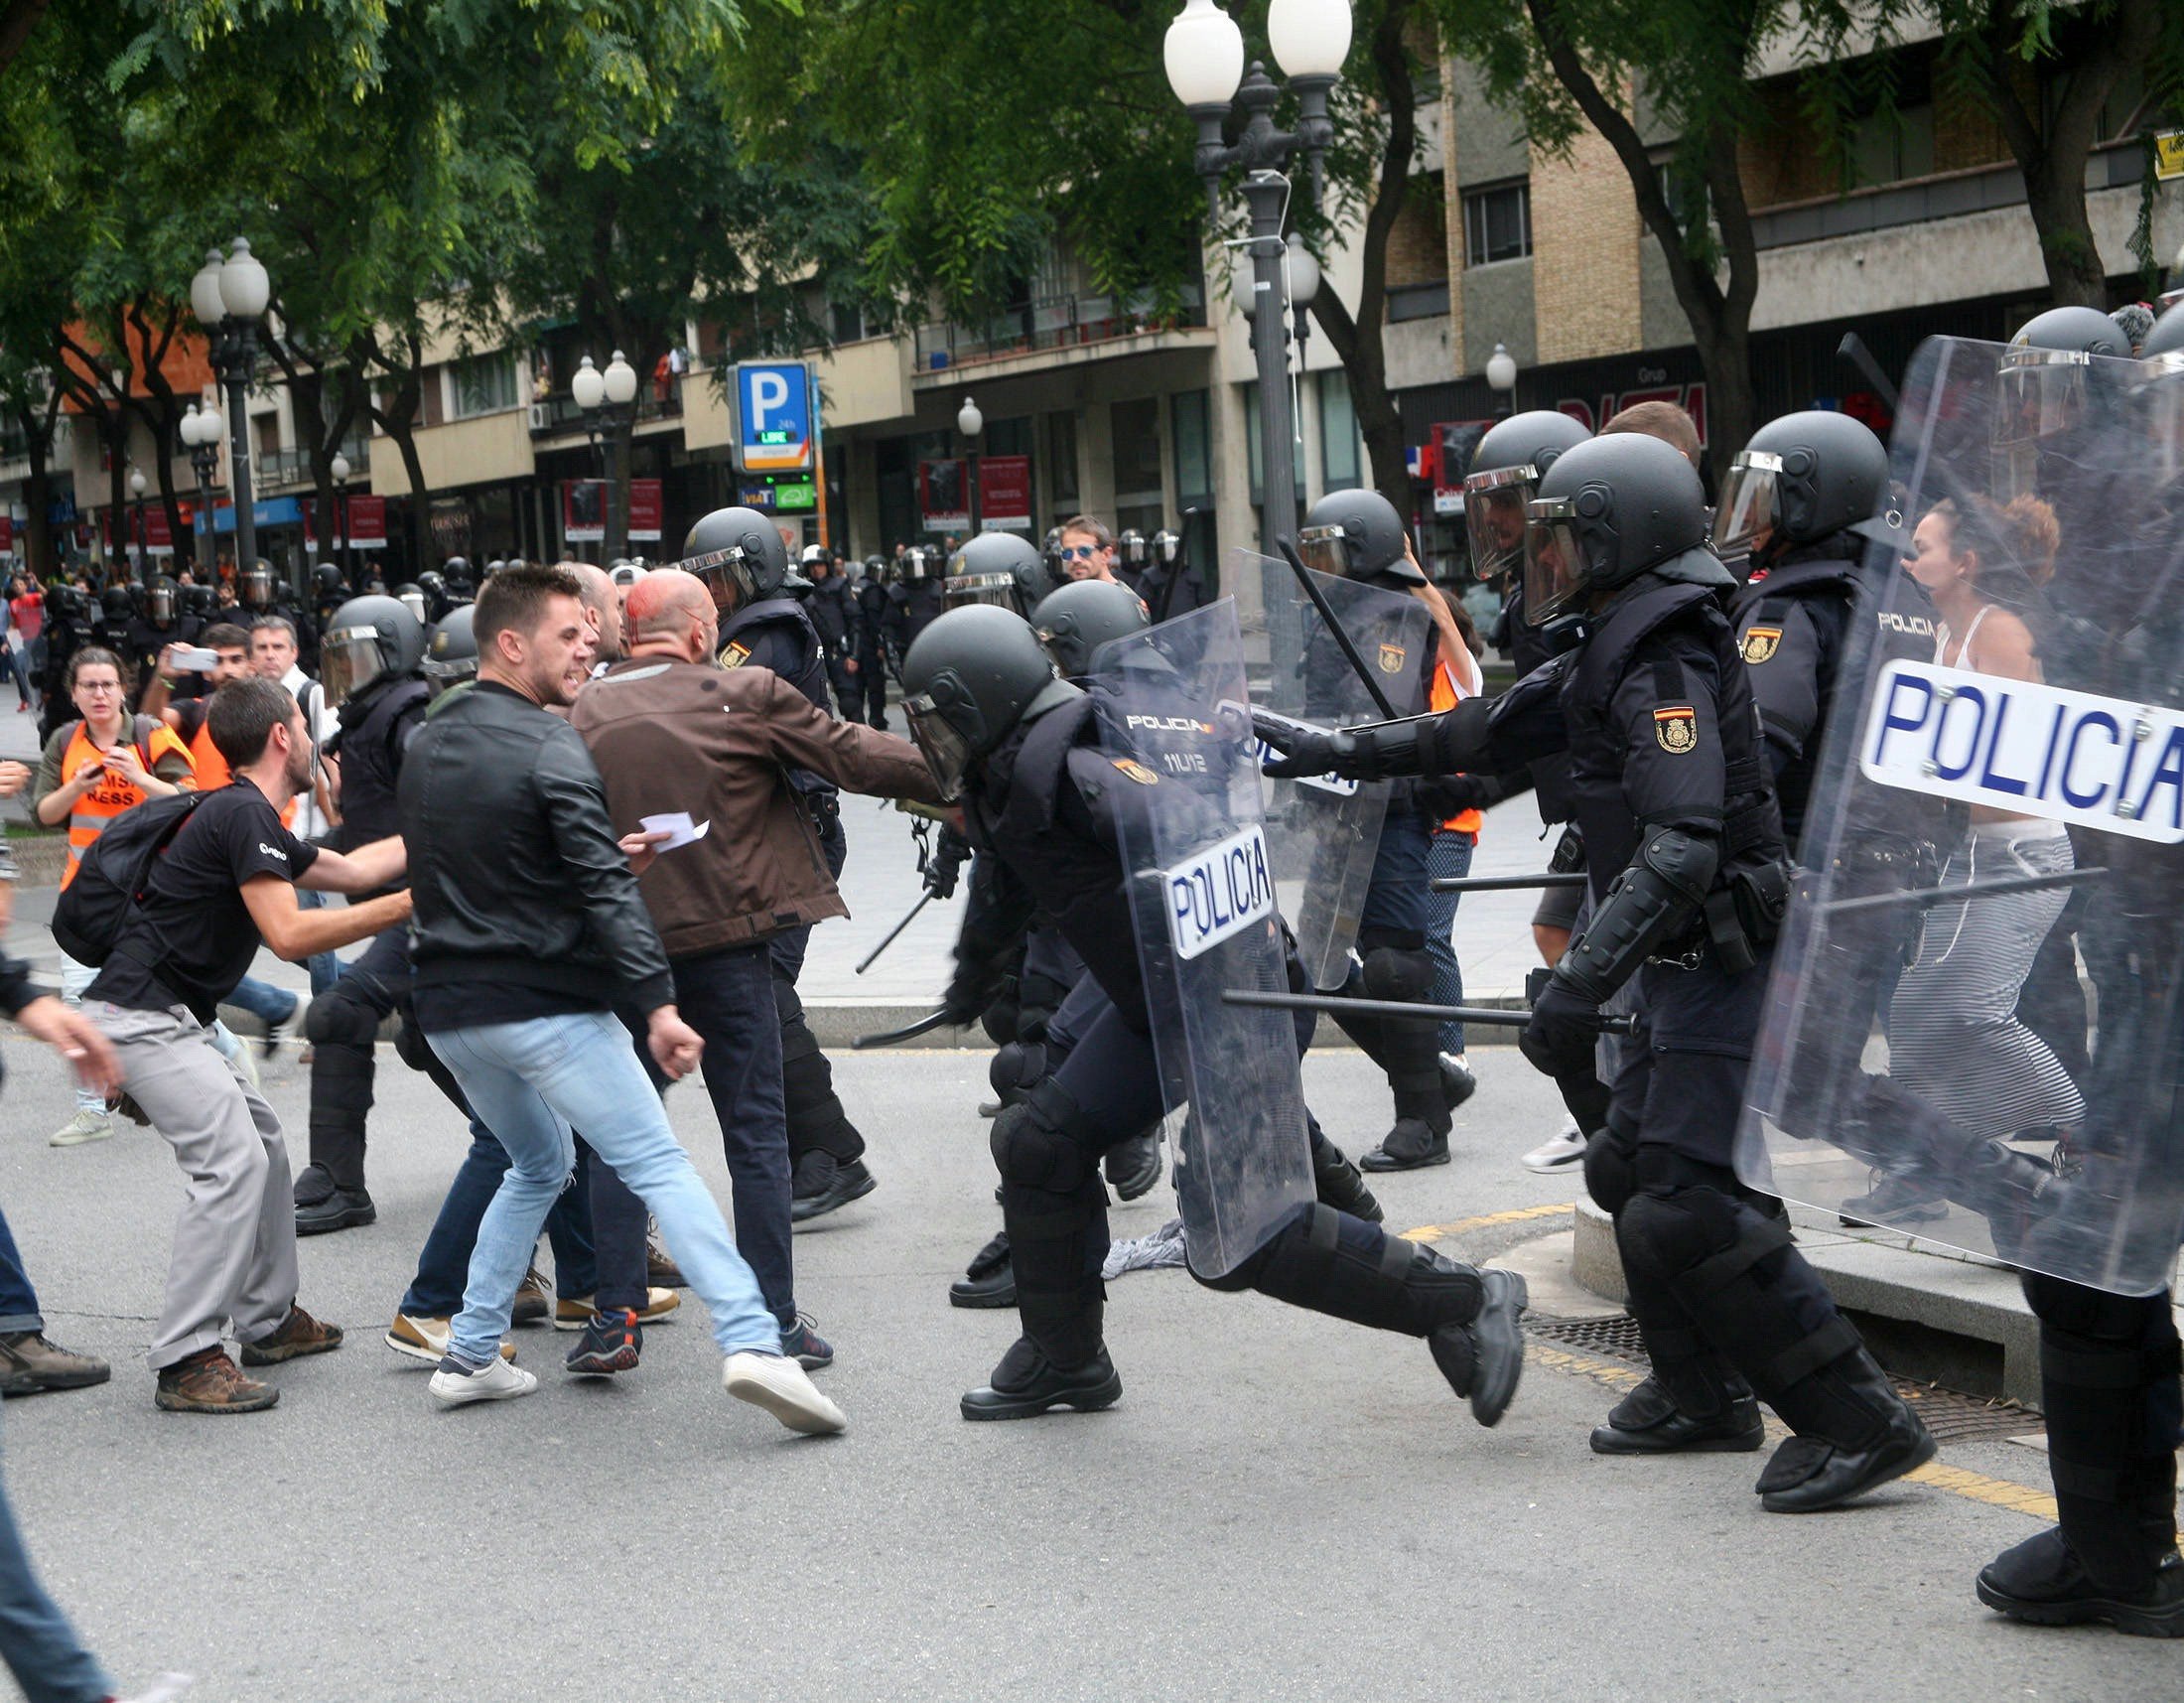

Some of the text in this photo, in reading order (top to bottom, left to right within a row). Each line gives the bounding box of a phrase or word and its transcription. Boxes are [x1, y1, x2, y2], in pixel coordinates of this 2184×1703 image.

[1638, 367, 1667, 382] Grup
[751, 372, 788, 430] P
[1878, 612, 1938, 637] POLICIA
[1126, 715, 1205, 732] POLICIA
[1875, 672, 2184, 830] POLICIA
[87, 790, 134, 805] RESS
[1172, 836, 1272, 947] POLICIA
